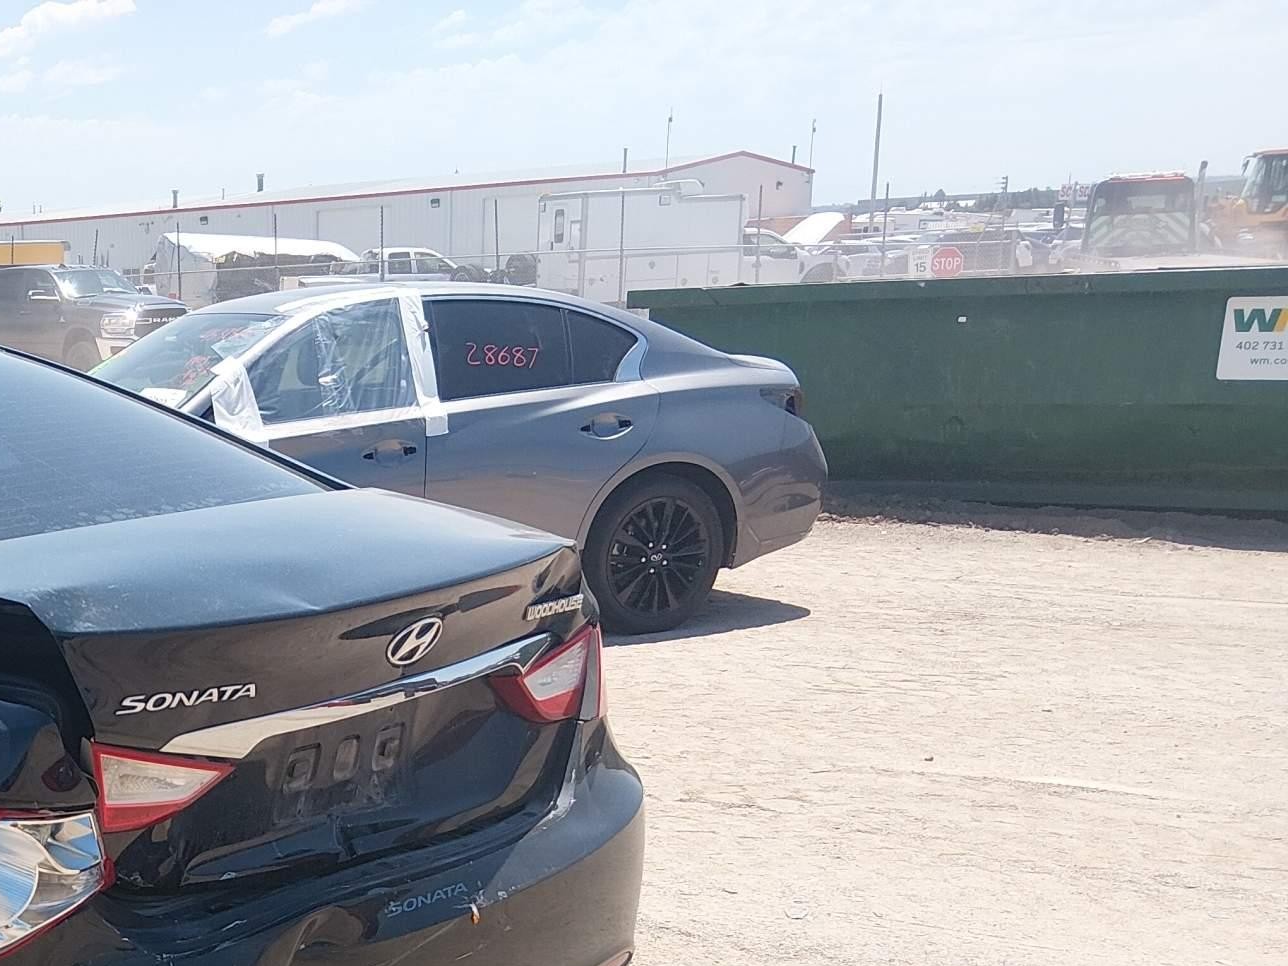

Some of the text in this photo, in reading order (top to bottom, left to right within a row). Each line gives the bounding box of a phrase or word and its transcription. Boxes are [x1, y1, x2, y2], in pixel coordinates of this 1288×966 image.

[914, 262, 927, 273] 15
[932, 257, 961, 271] STOP
[465, 342, 539, 369] 28687
[1235, 340, 1284, 351] 402 731
[1250, 357, 1288, 366] wm.co
[526, 593, 585, 621] WOODHOUSE
[115, 683, 257, 716] SONATA
[385, 882, 469, 918] SONATA
